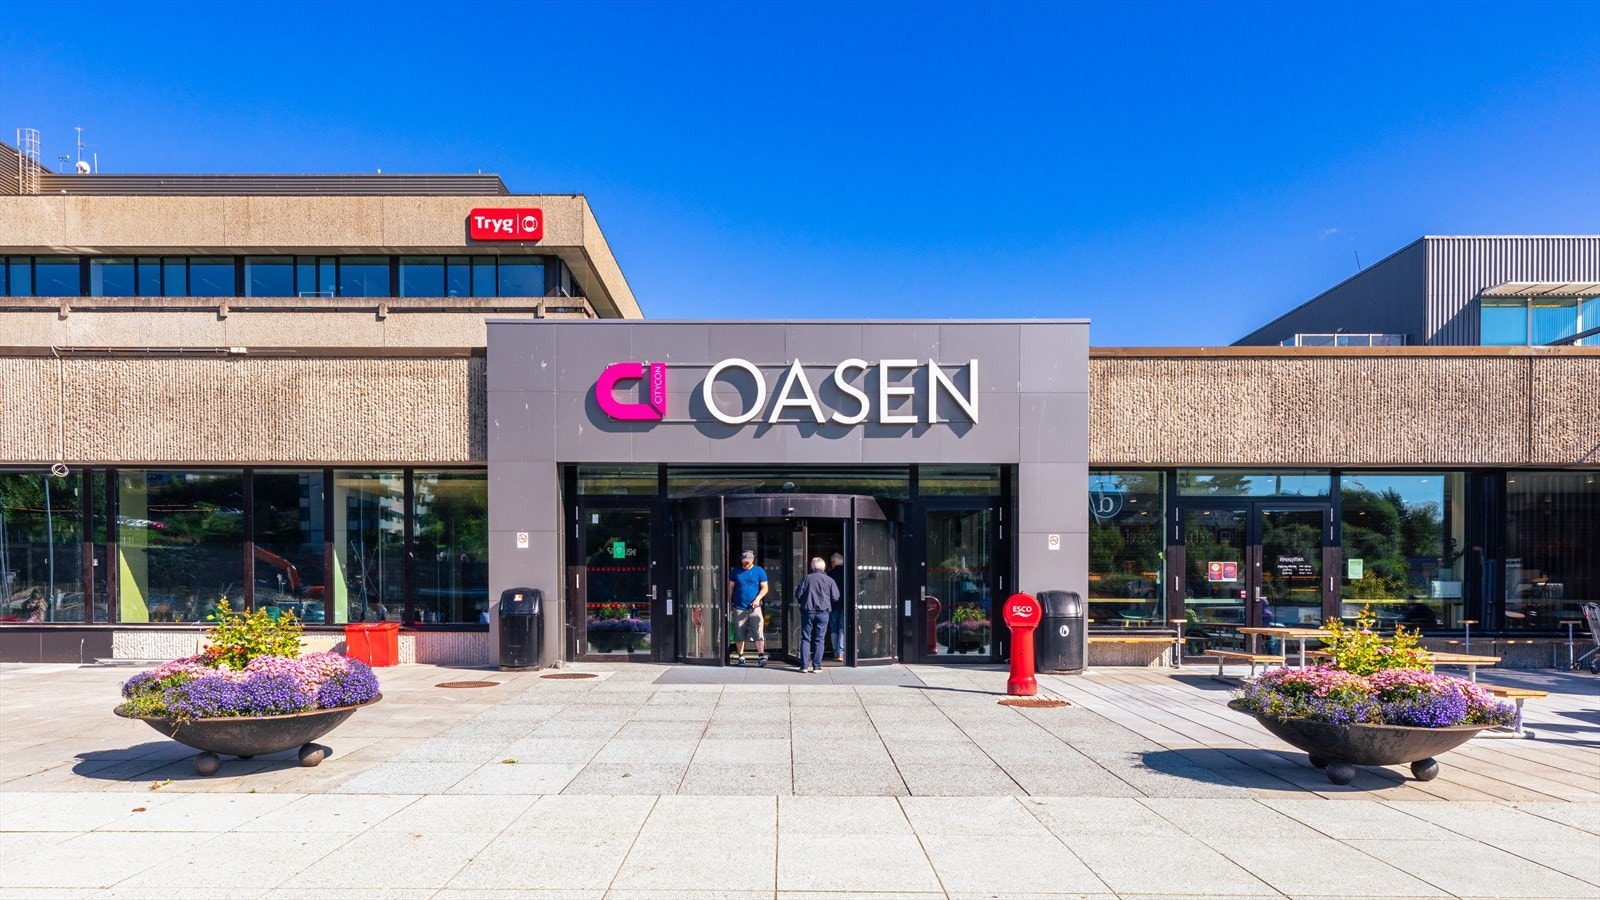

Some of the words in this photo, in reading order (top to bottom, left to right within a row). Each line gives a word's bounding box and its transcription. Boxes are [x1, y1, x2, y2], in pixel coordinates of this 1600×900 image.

[474, 216, 514, 234] Tryg
[654, 366, 663, 405] CITYCON
[702, 358, 979, 425] OASEN
[1012, 605, 1033, 613] ESCO
